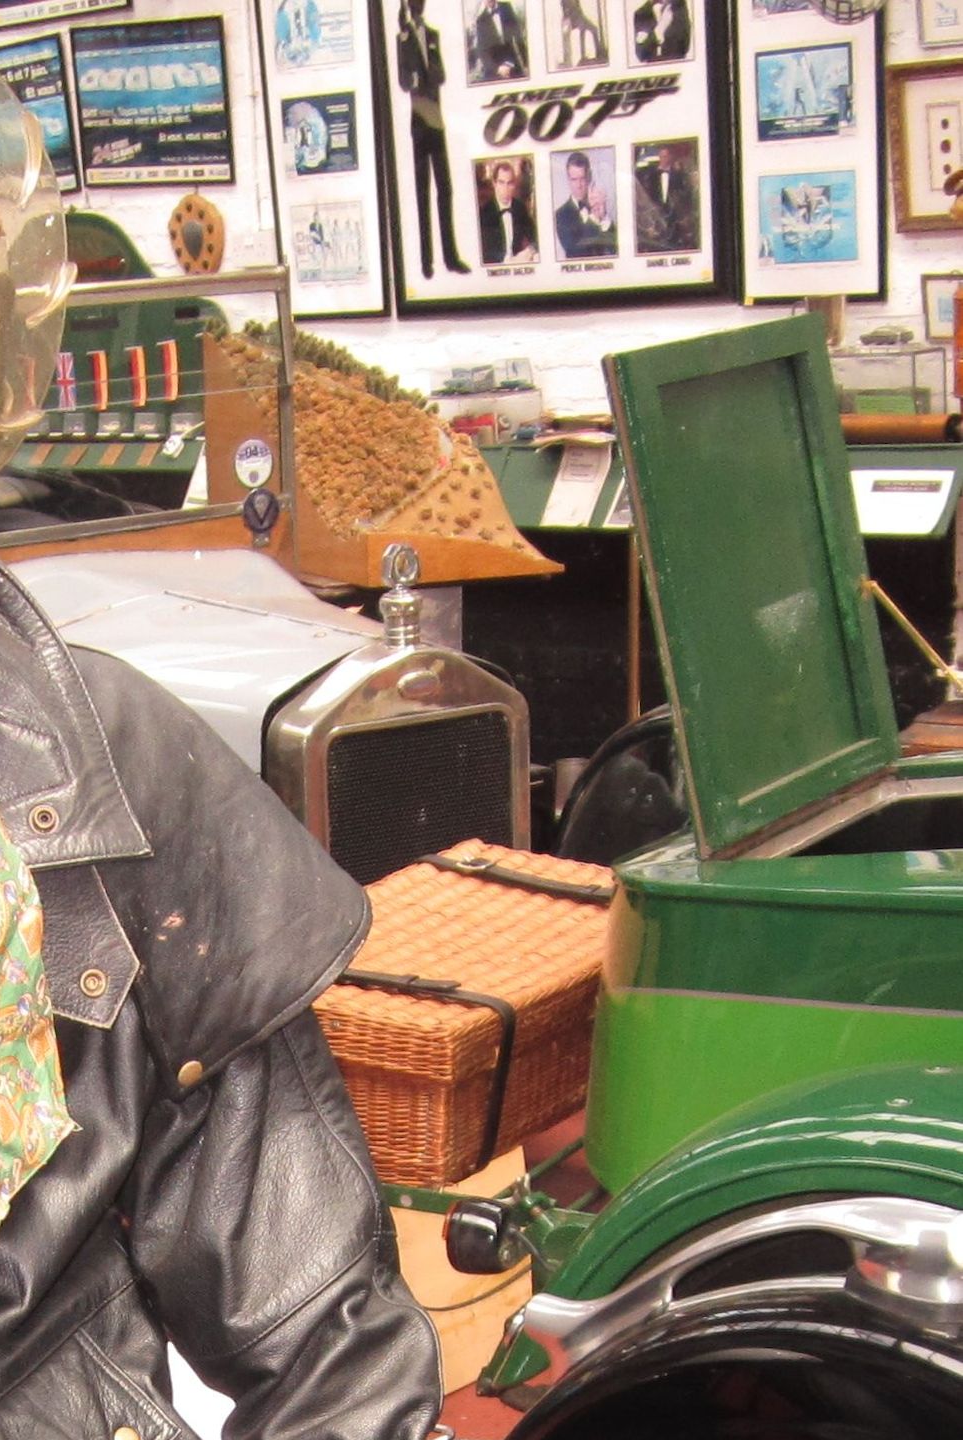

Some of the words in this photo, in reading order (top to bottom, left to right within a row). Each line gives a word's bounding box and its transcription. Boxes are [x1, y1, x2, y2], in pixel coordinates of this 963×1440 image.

[482, 84, 584, 109] JAMES
[592, 73, 681, 96] BOND
[483, 91, 641, 147] 007
